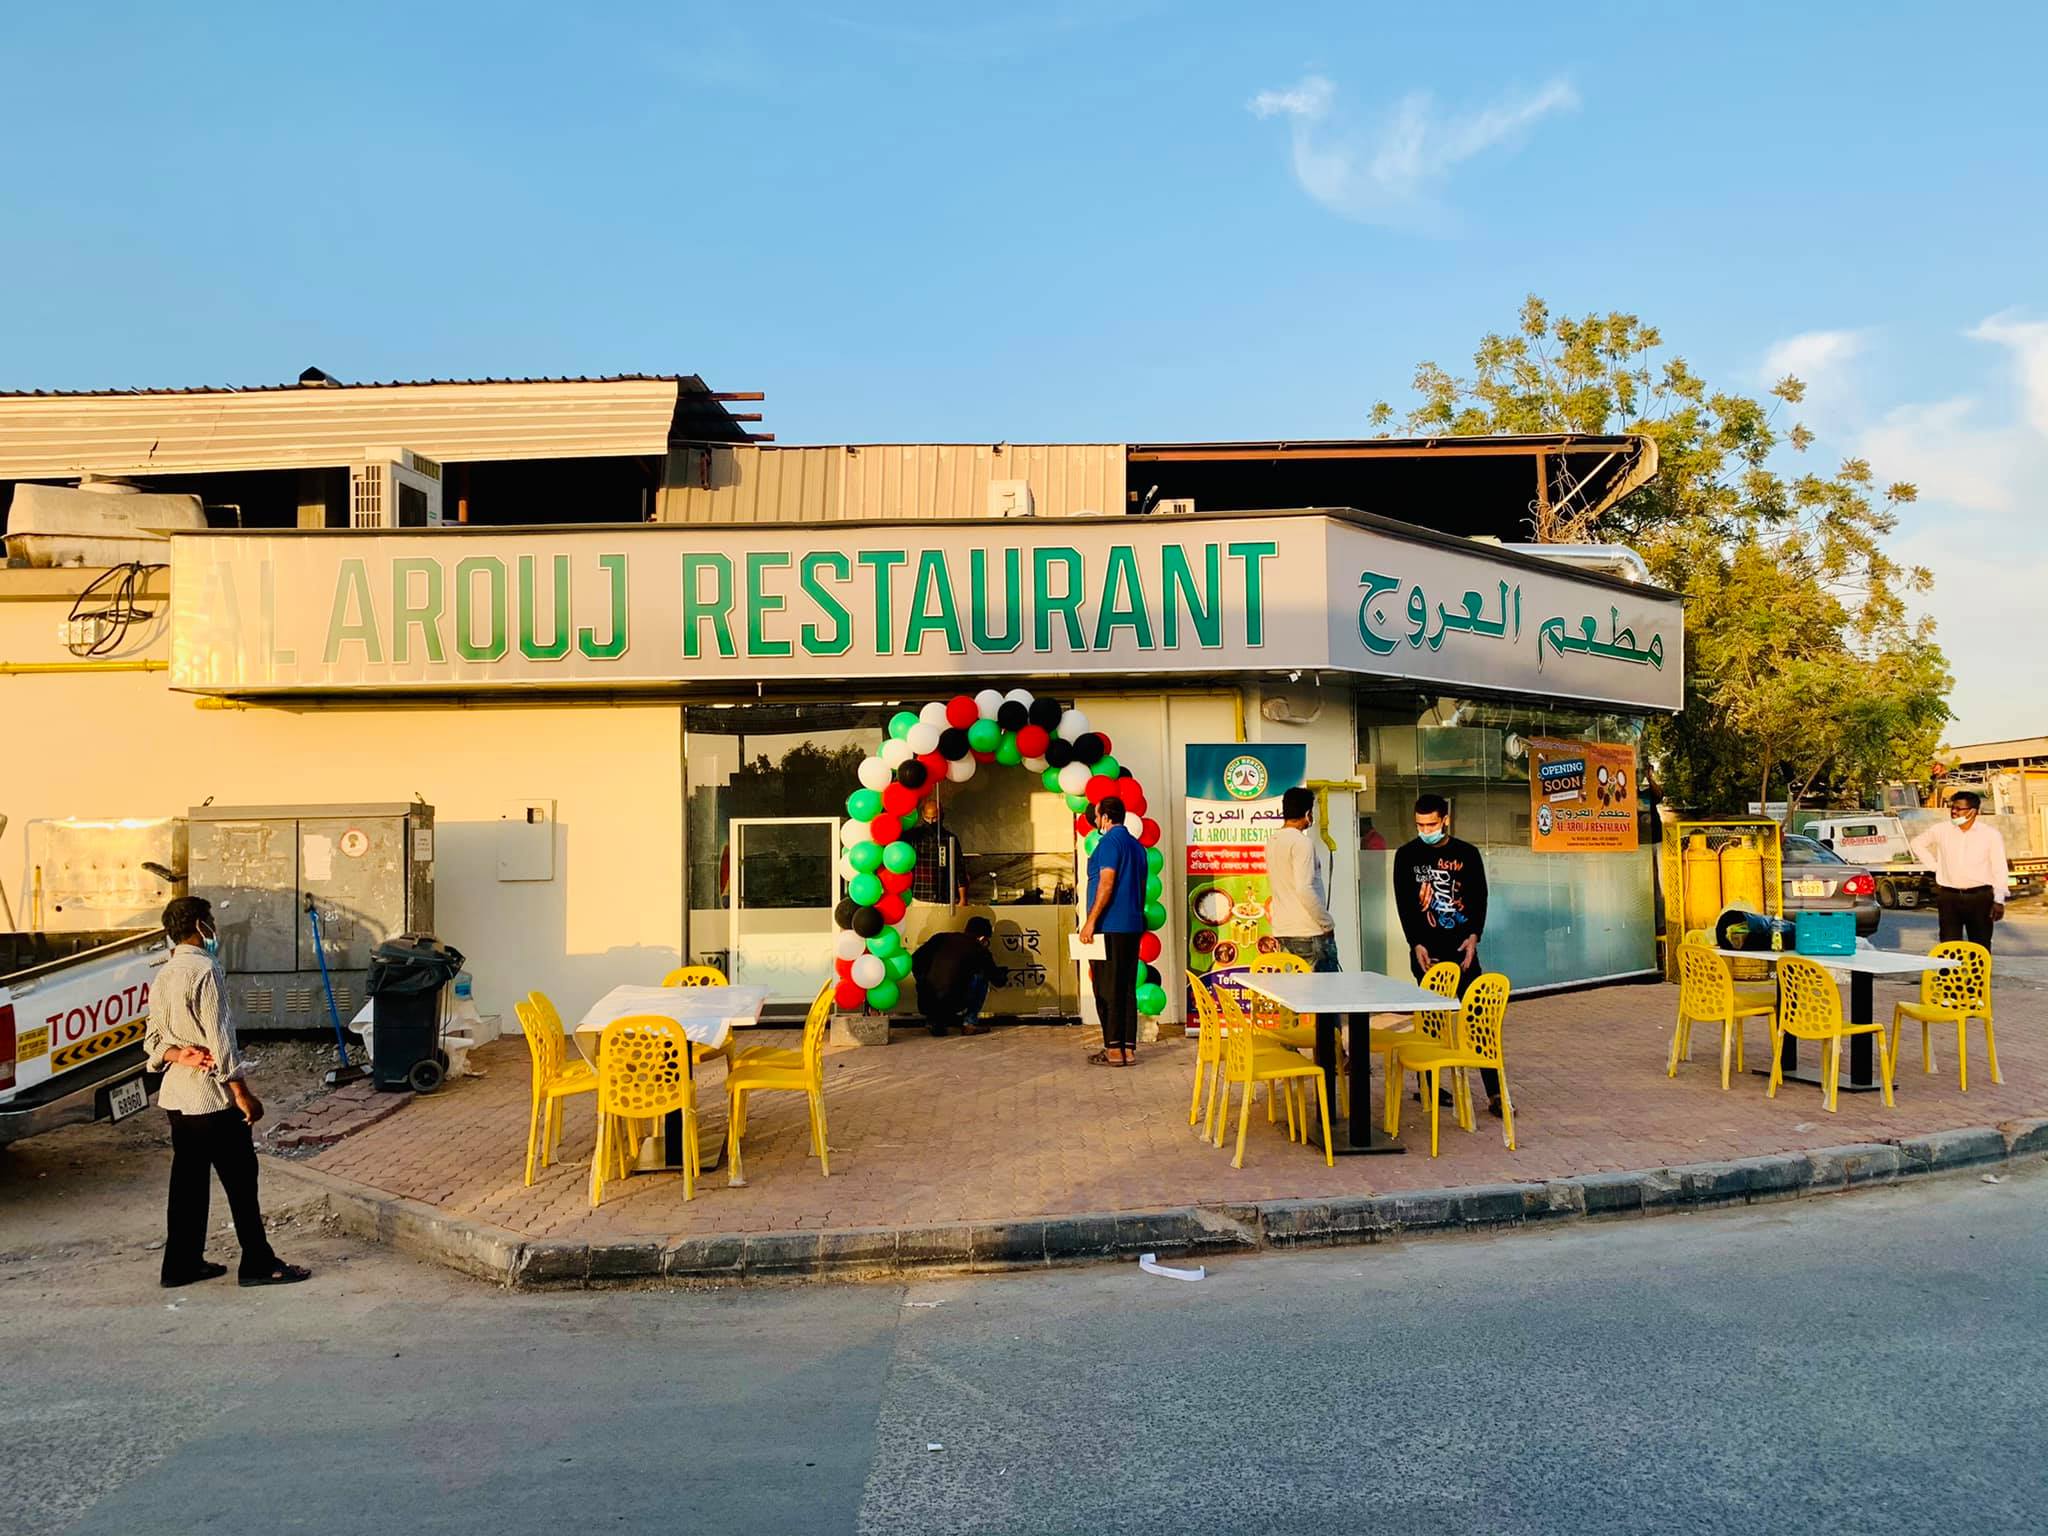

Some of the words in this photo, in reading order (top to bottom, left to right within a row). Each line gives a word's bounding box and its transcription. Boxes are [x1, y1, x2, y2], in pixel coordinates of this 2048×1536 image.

[200, 558, 297, 667] AL
[321, 552, 630, 665] AROUJ
[681, 540, 1280, 659] RESTAURANT
[1357, 569, 1523, 656] العروج
[1537, 602, 1665, 674] مطعم
[1541, 762, 1584, 777] OPENING
[1544, 776, 1581, 792] SOON
[1192, 808, 1244, 825] العروج
[1555, 807, 1594, 821] العروج
[1597, 808, 1632, 820] مطعم
[1191, 828, 1204, 842] AL
[1208, 828, 1238, 842] AROUJ
[1000, 927, 1042, 956] ভাই
[45, 981, 150, 1047] TOYOTA
